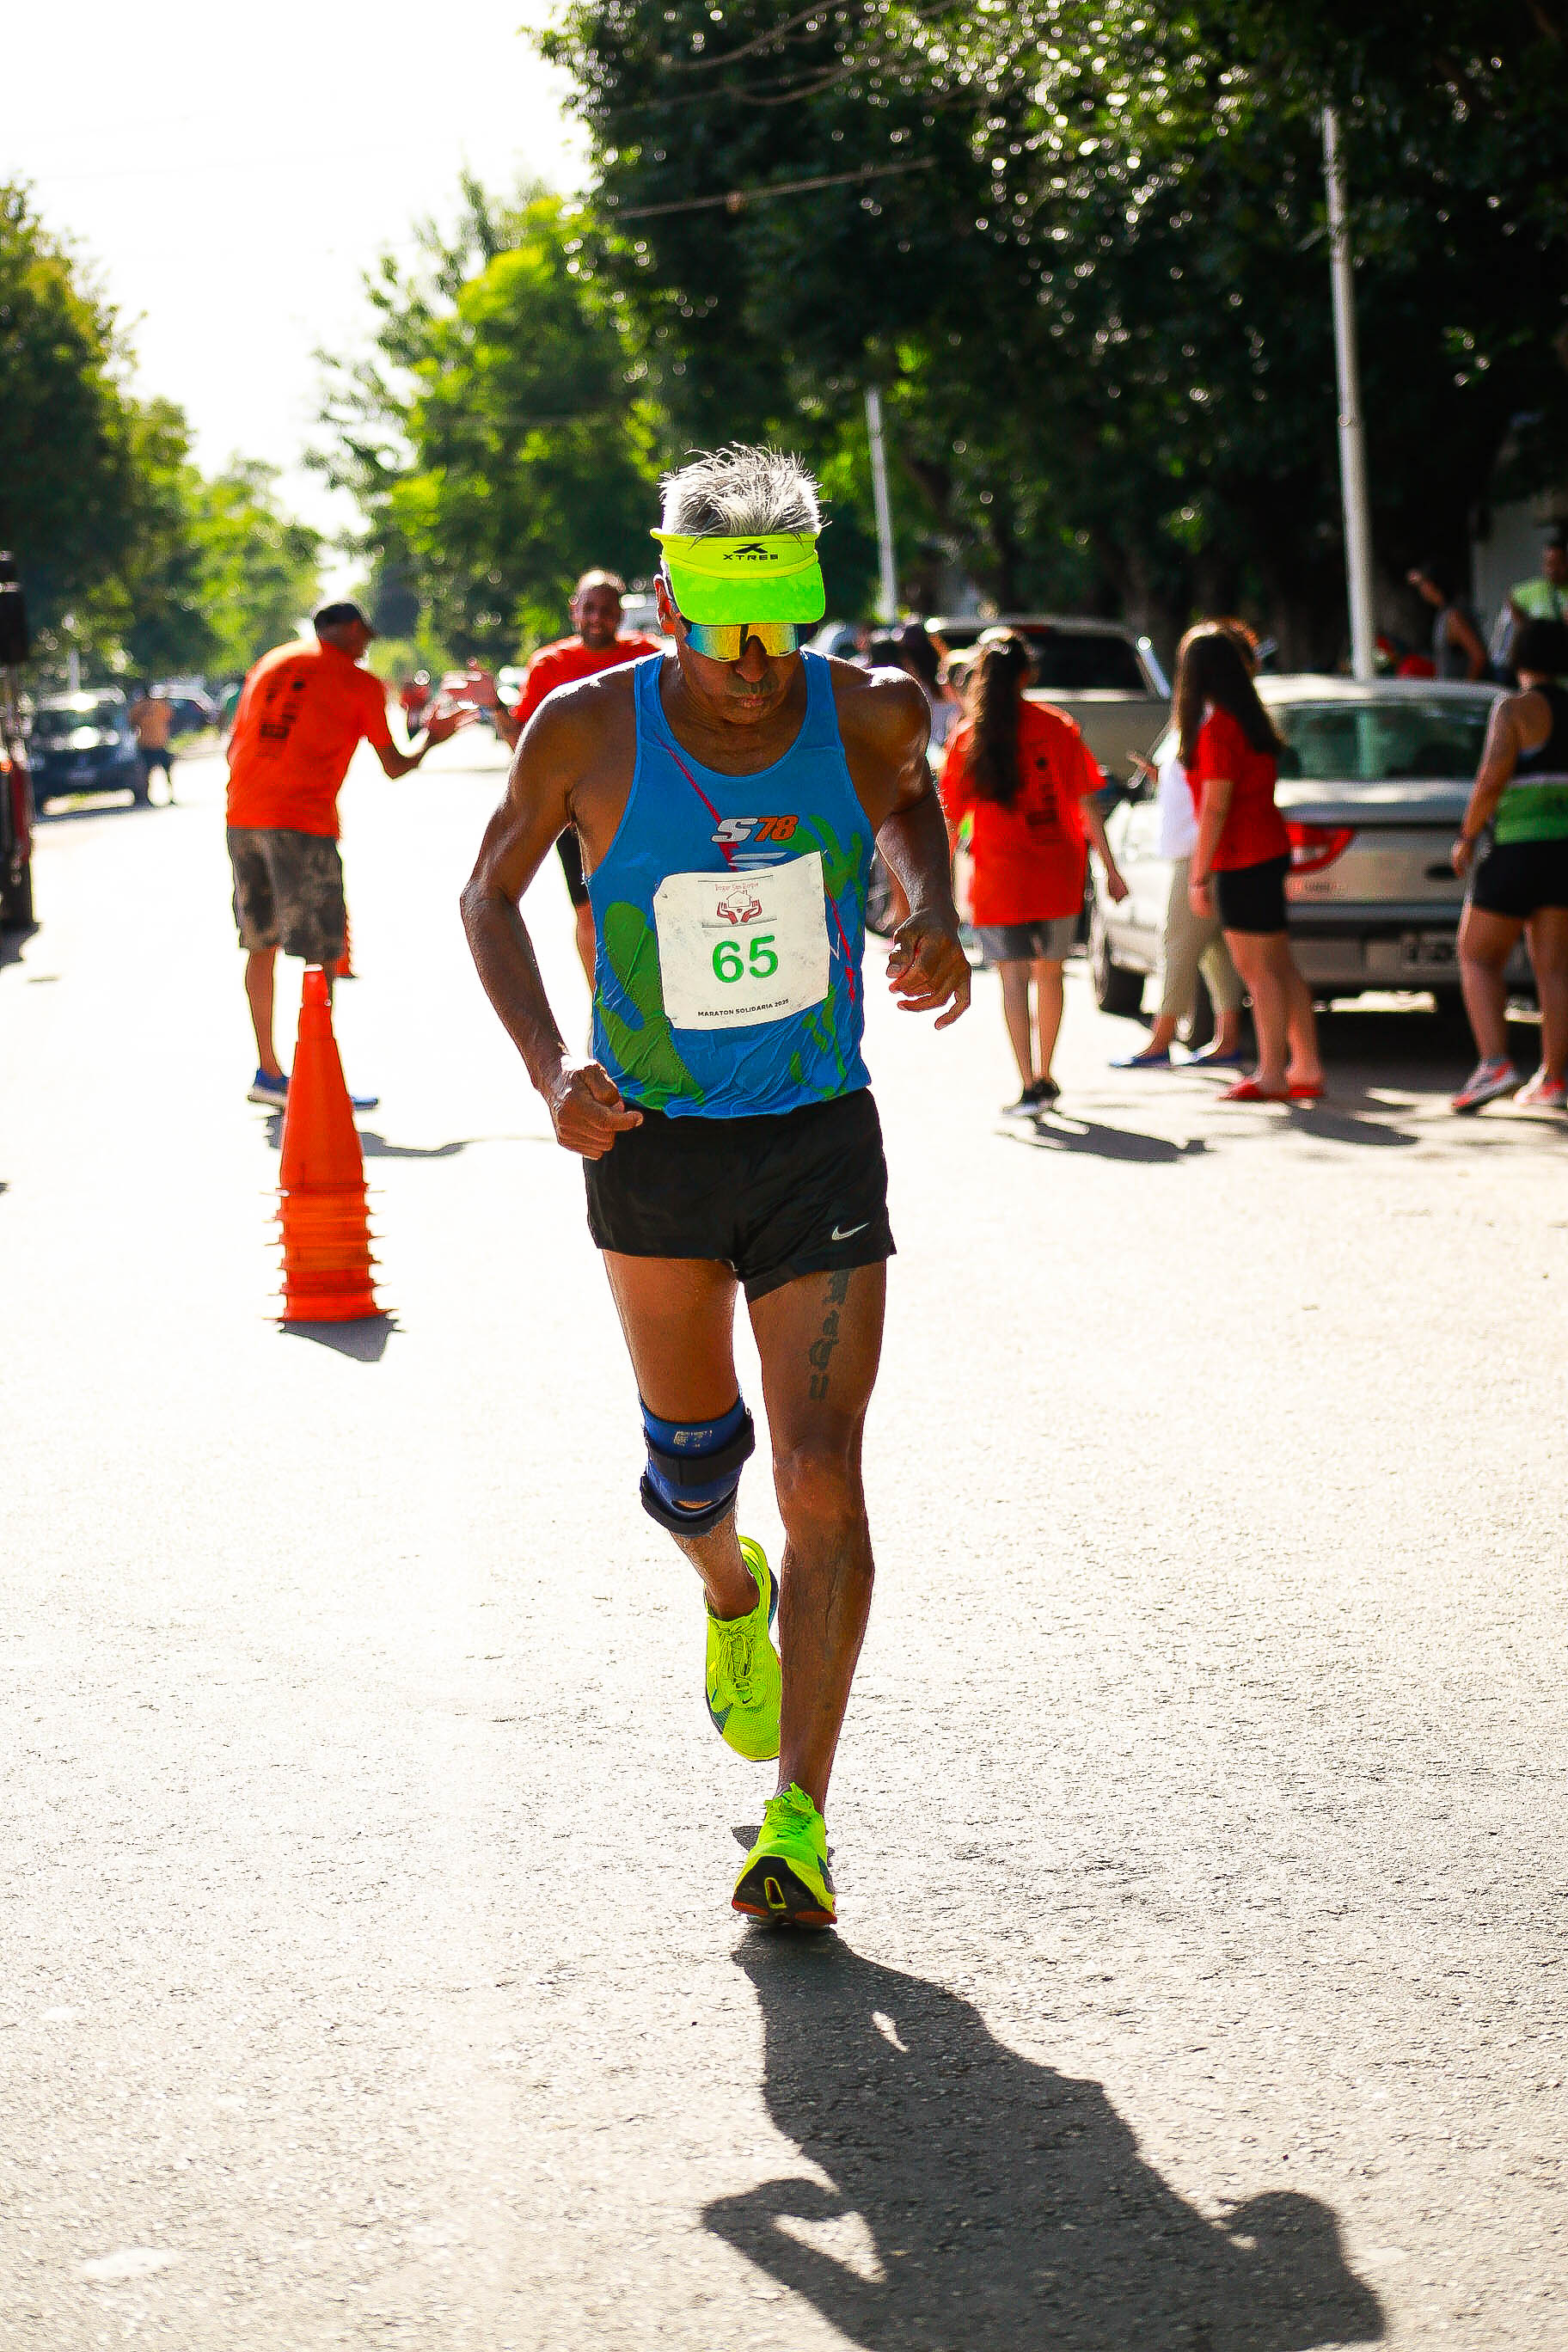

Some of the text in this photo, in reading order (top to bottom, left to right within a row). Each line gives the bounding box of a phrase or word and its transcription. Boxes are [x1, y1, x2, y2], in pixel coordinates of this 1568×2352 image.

[712, 934, 779, 983] 65
[735, 1003, 773, 1014] SOLIDARIA
[774, 998, 789, 1008] 2025
